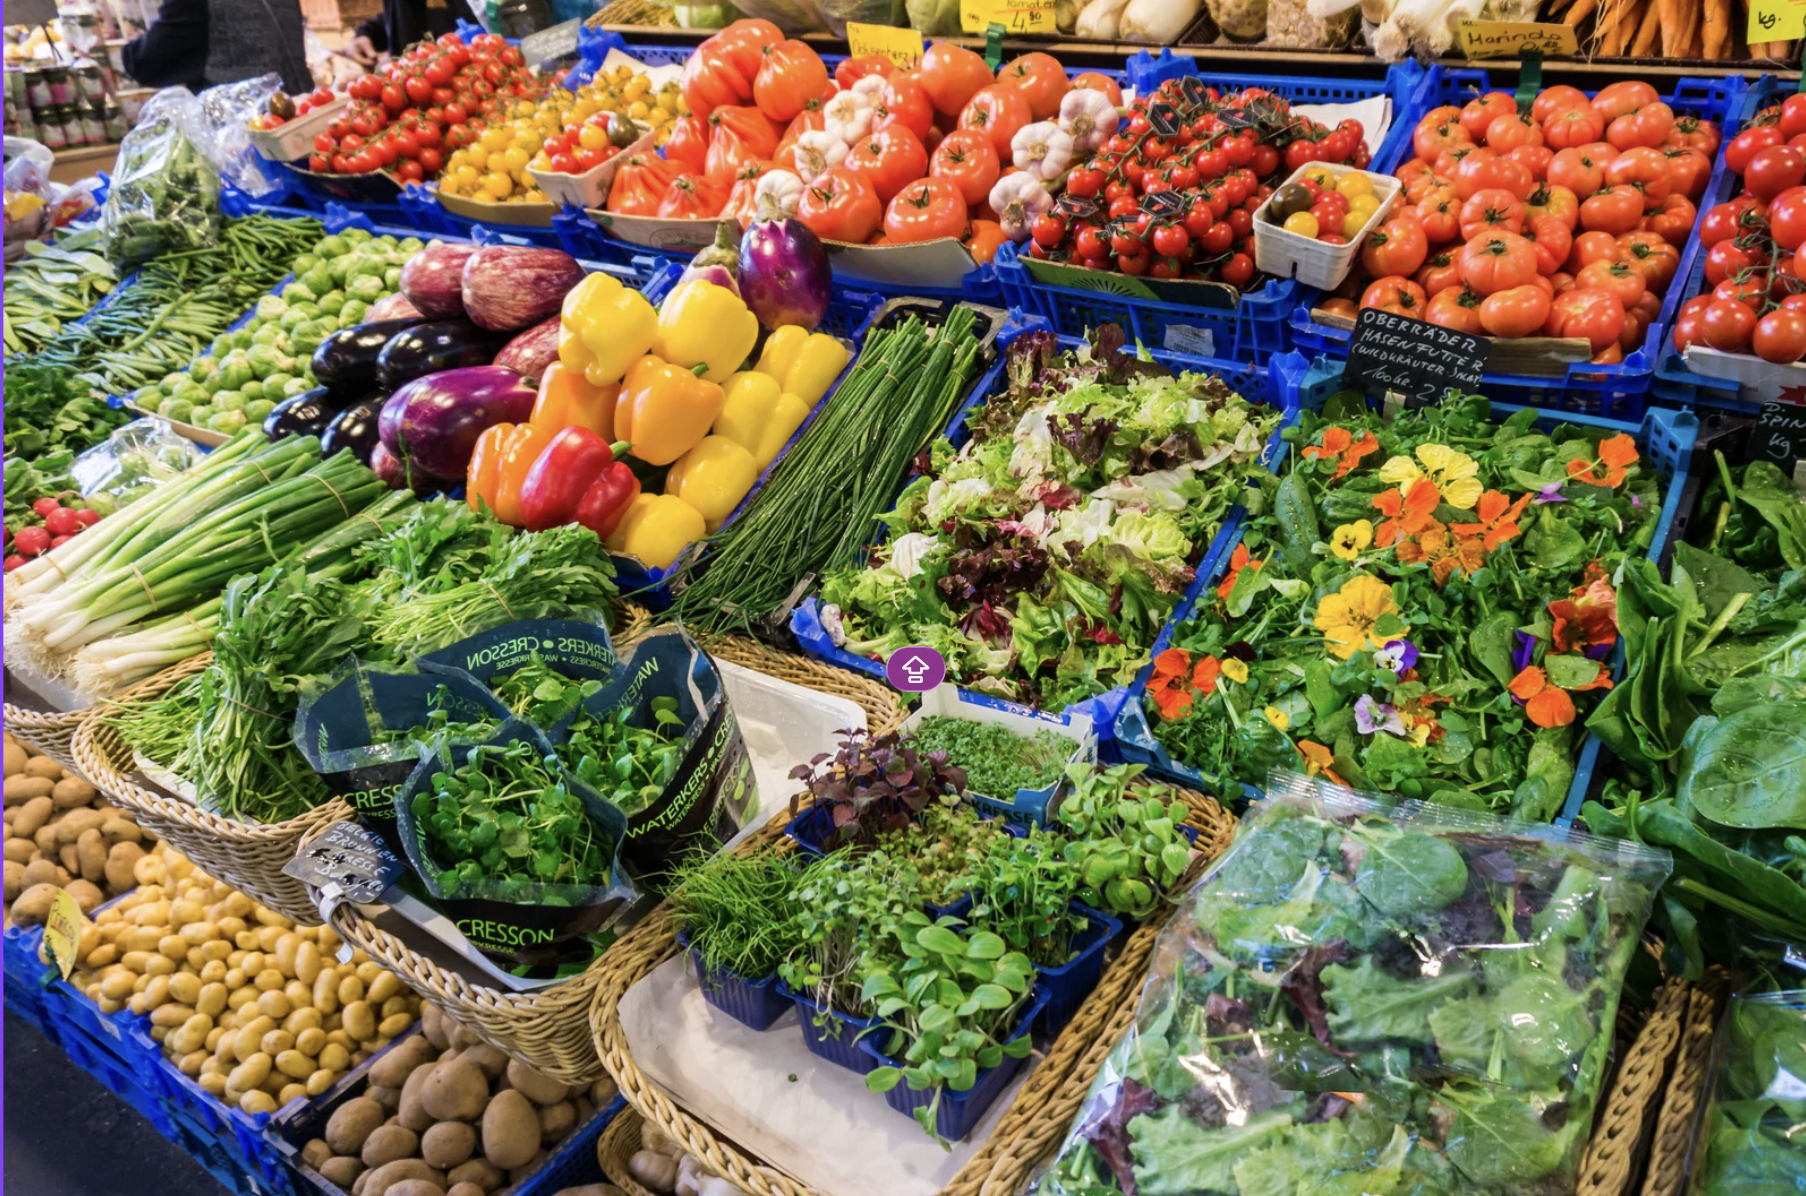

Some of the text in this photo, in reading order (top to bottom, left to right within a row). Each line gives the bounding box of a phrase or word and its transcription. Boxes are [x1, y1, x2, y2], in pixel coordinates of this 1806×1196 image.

[1363, 311, 1477, 352] OBERRÄDER
[1764, 402, 1786, 413] D.
[626, 757, 708, 838] WATERKERS
[456, 919, 554, 946] CRESSON
